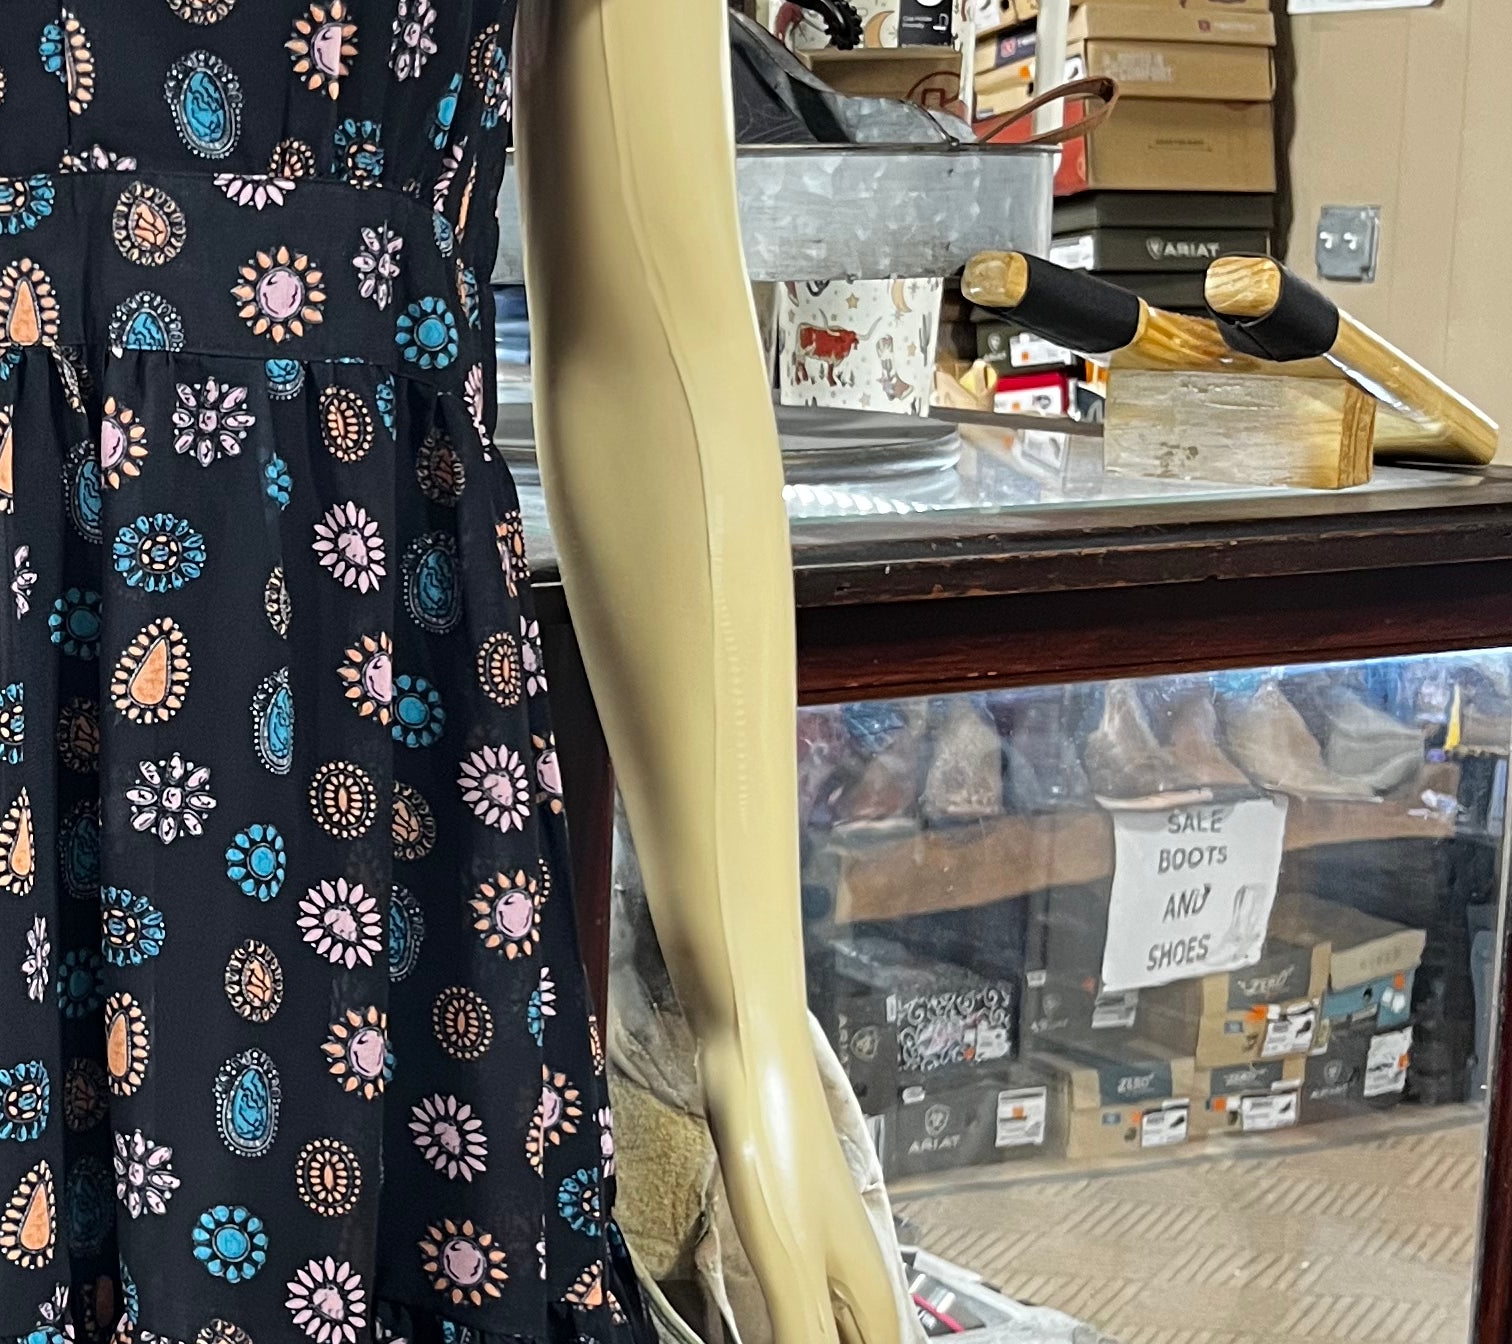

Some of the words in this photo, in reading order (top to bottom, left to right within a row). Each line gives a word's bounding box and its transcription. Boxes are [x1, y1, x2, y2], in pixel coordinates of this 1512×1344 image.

[1162, 242, 1220, 258] ARIAT
[1168, 808, 1226, 834] SALE
[1157, 845, 1228, 875] BOOTS
[1162, 882, 1212, 924] AND
[1146, 934, 1212, 972] SHOES
[907, 1134, 961, 1155] ARIAT
